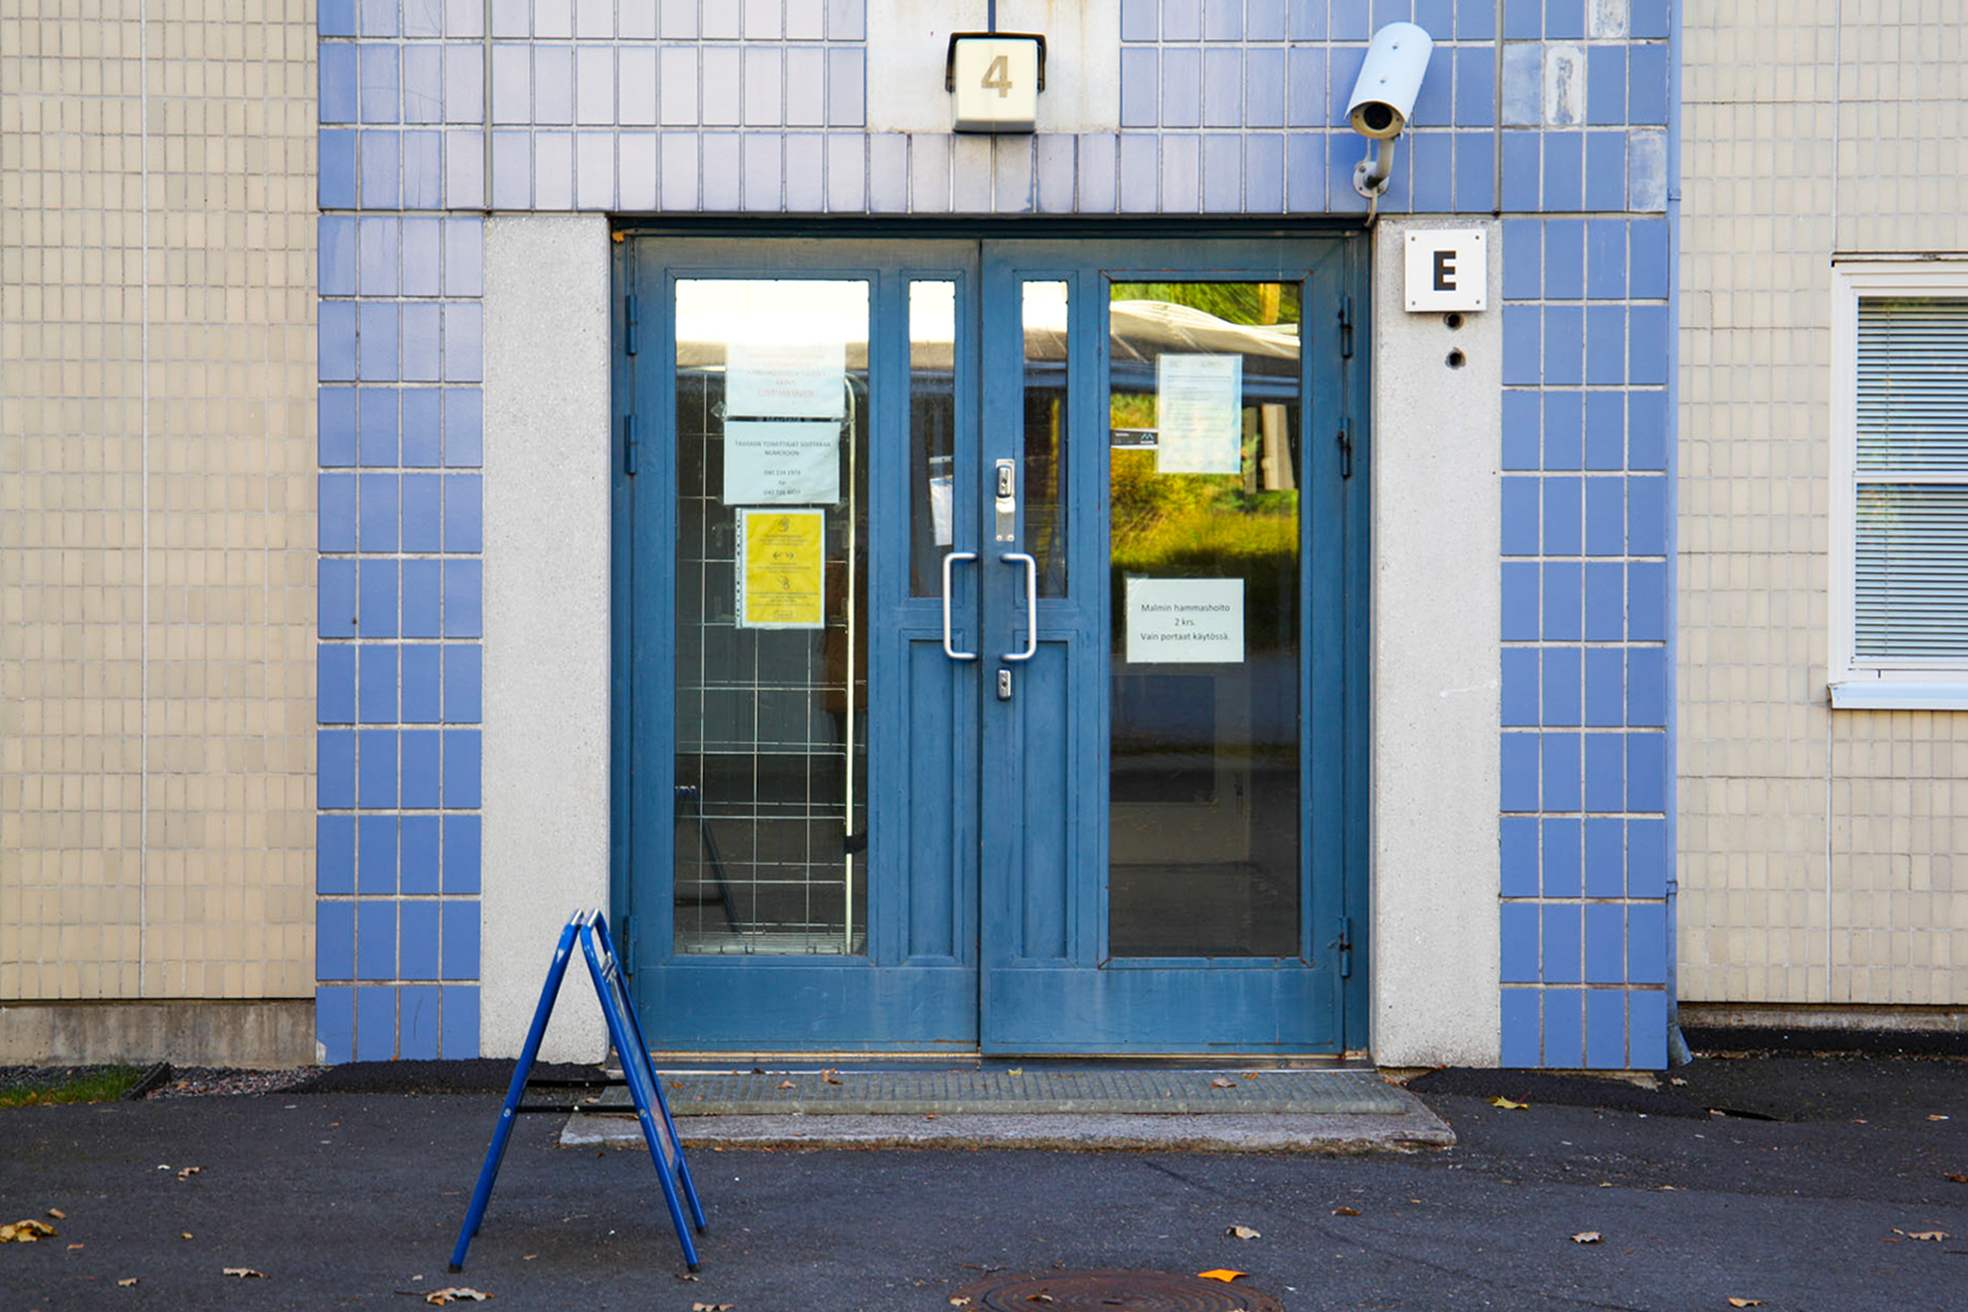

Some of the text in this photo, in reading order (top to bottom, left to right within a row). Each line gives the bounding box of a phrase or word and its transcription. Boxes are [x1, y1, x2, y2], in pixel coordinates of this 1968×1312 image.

[981, 55, 1013, 98] 4
[1433, 251, 1457, 291] E
[1141, 604, 1231, 612] Malmin hammashoito
[1174, 617, 1196, 626] 2 krs.
[1140, 632, 1231, 642] Vain portaat käytössä.
